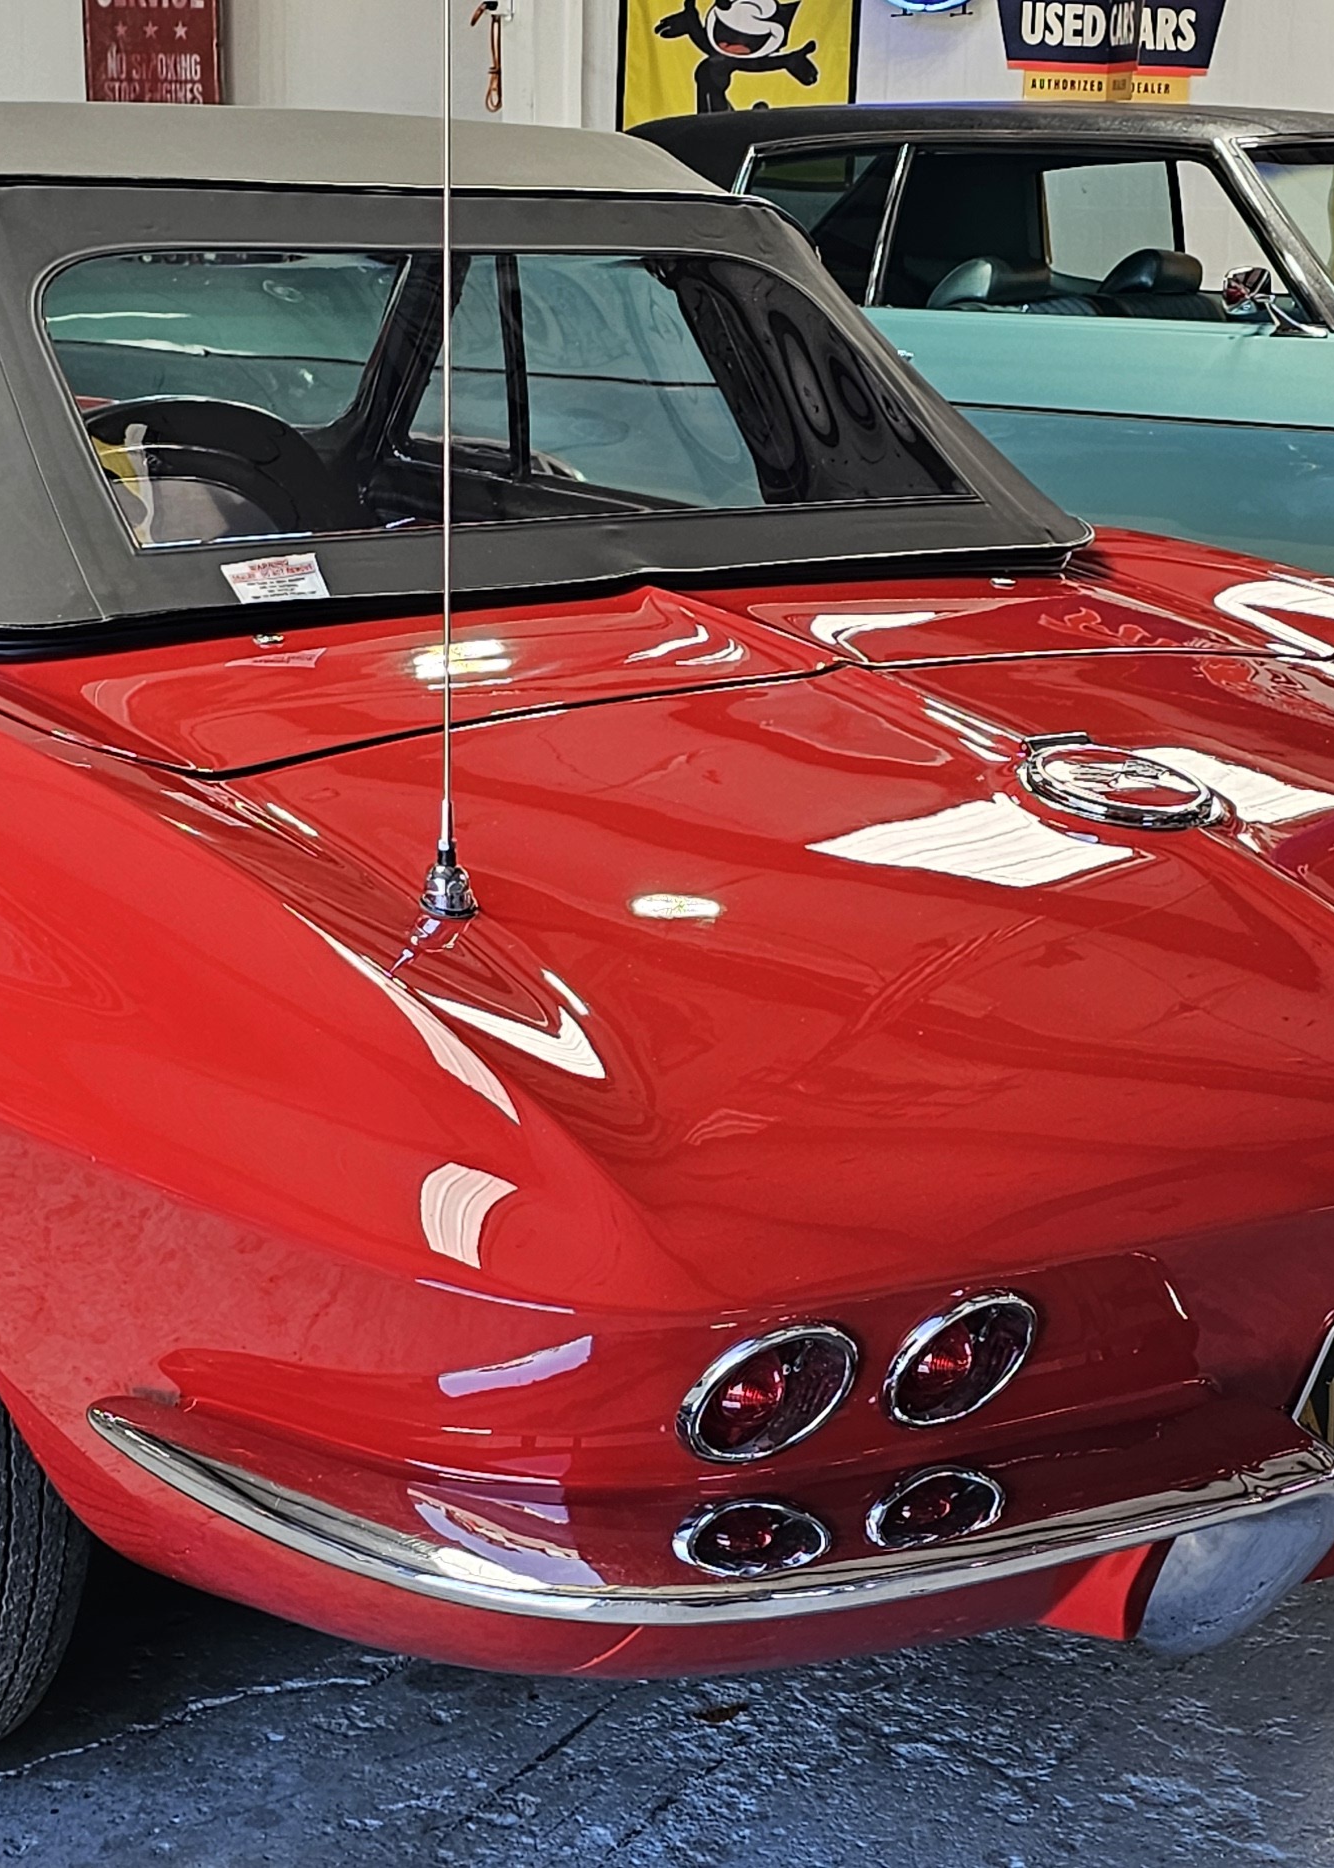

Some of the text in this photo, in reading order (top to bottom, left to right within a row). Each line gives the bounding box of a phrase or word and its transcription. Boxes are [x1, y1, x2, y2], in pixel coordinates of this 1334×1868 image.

[1021, 1, 1197, 51] USED ARS
[107, 42, 127, 79] NO
[1030, 78, 1103, 93] AUTHORIZED
